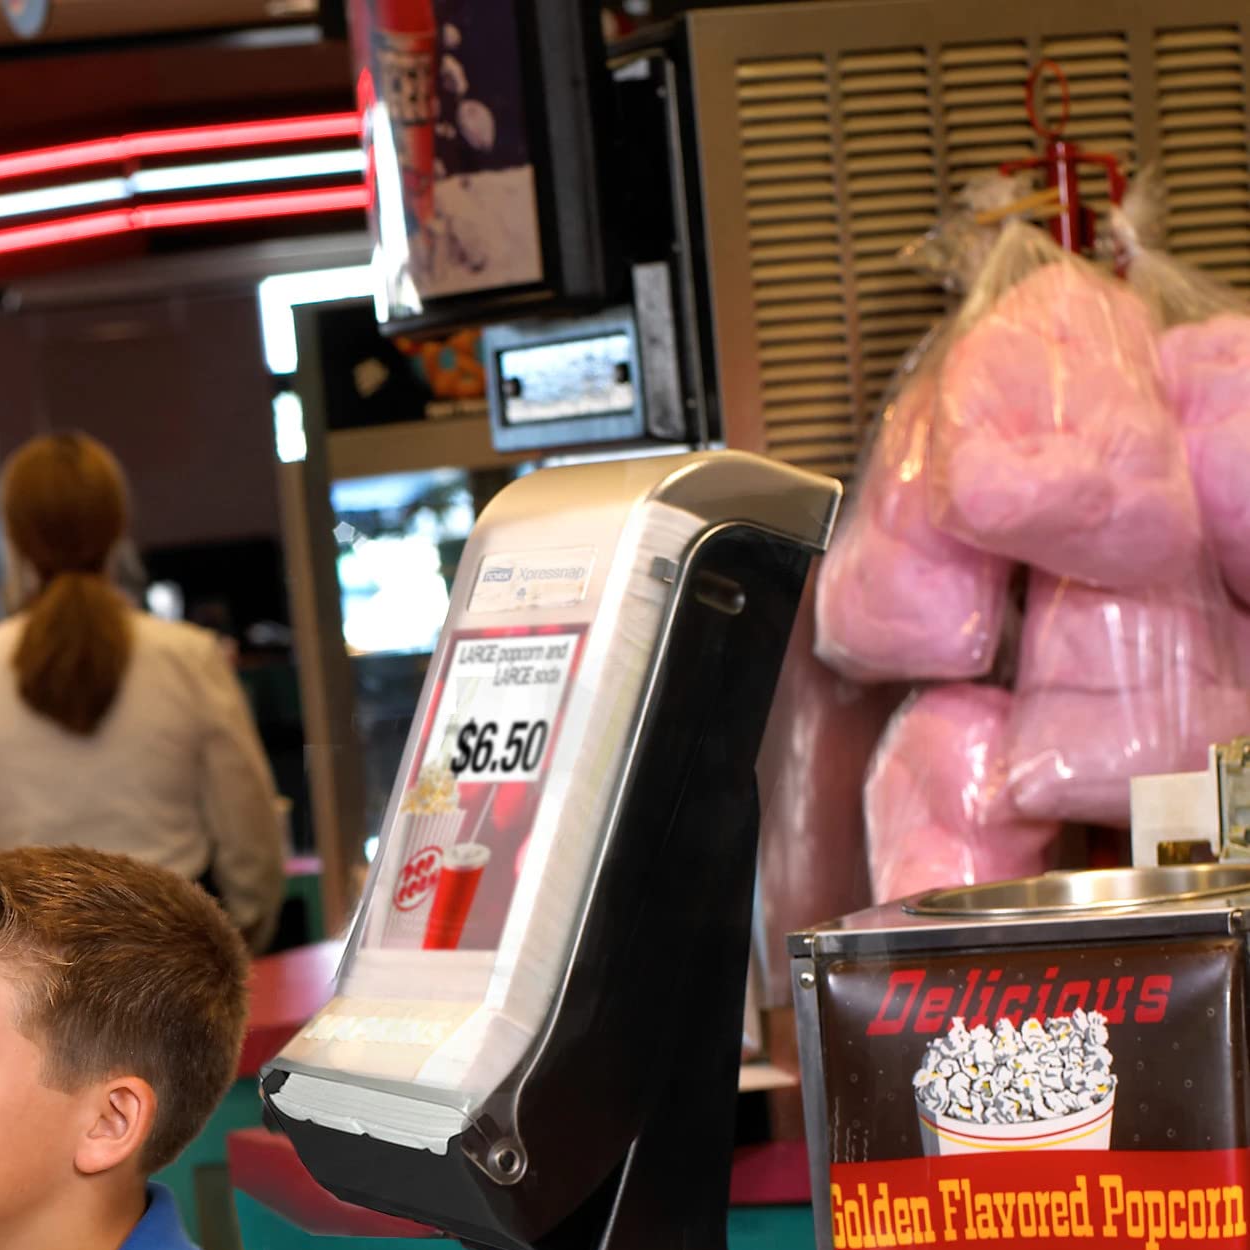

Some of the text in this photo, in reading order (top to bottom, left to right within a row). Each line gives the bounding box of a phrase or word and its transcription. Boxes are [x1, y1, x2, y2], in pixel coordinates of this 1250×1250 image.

[458, 641, 569, 664] LARGE popcorn and
[492, 666, 560, 687] LARGE soda
[451, 719, 548, 775] $6.50
[865, 965, 1173, 1037] Delicious
[830, 1182, 936, 1250] Golden
[939, 1175, 1095, 1242] Flavored
